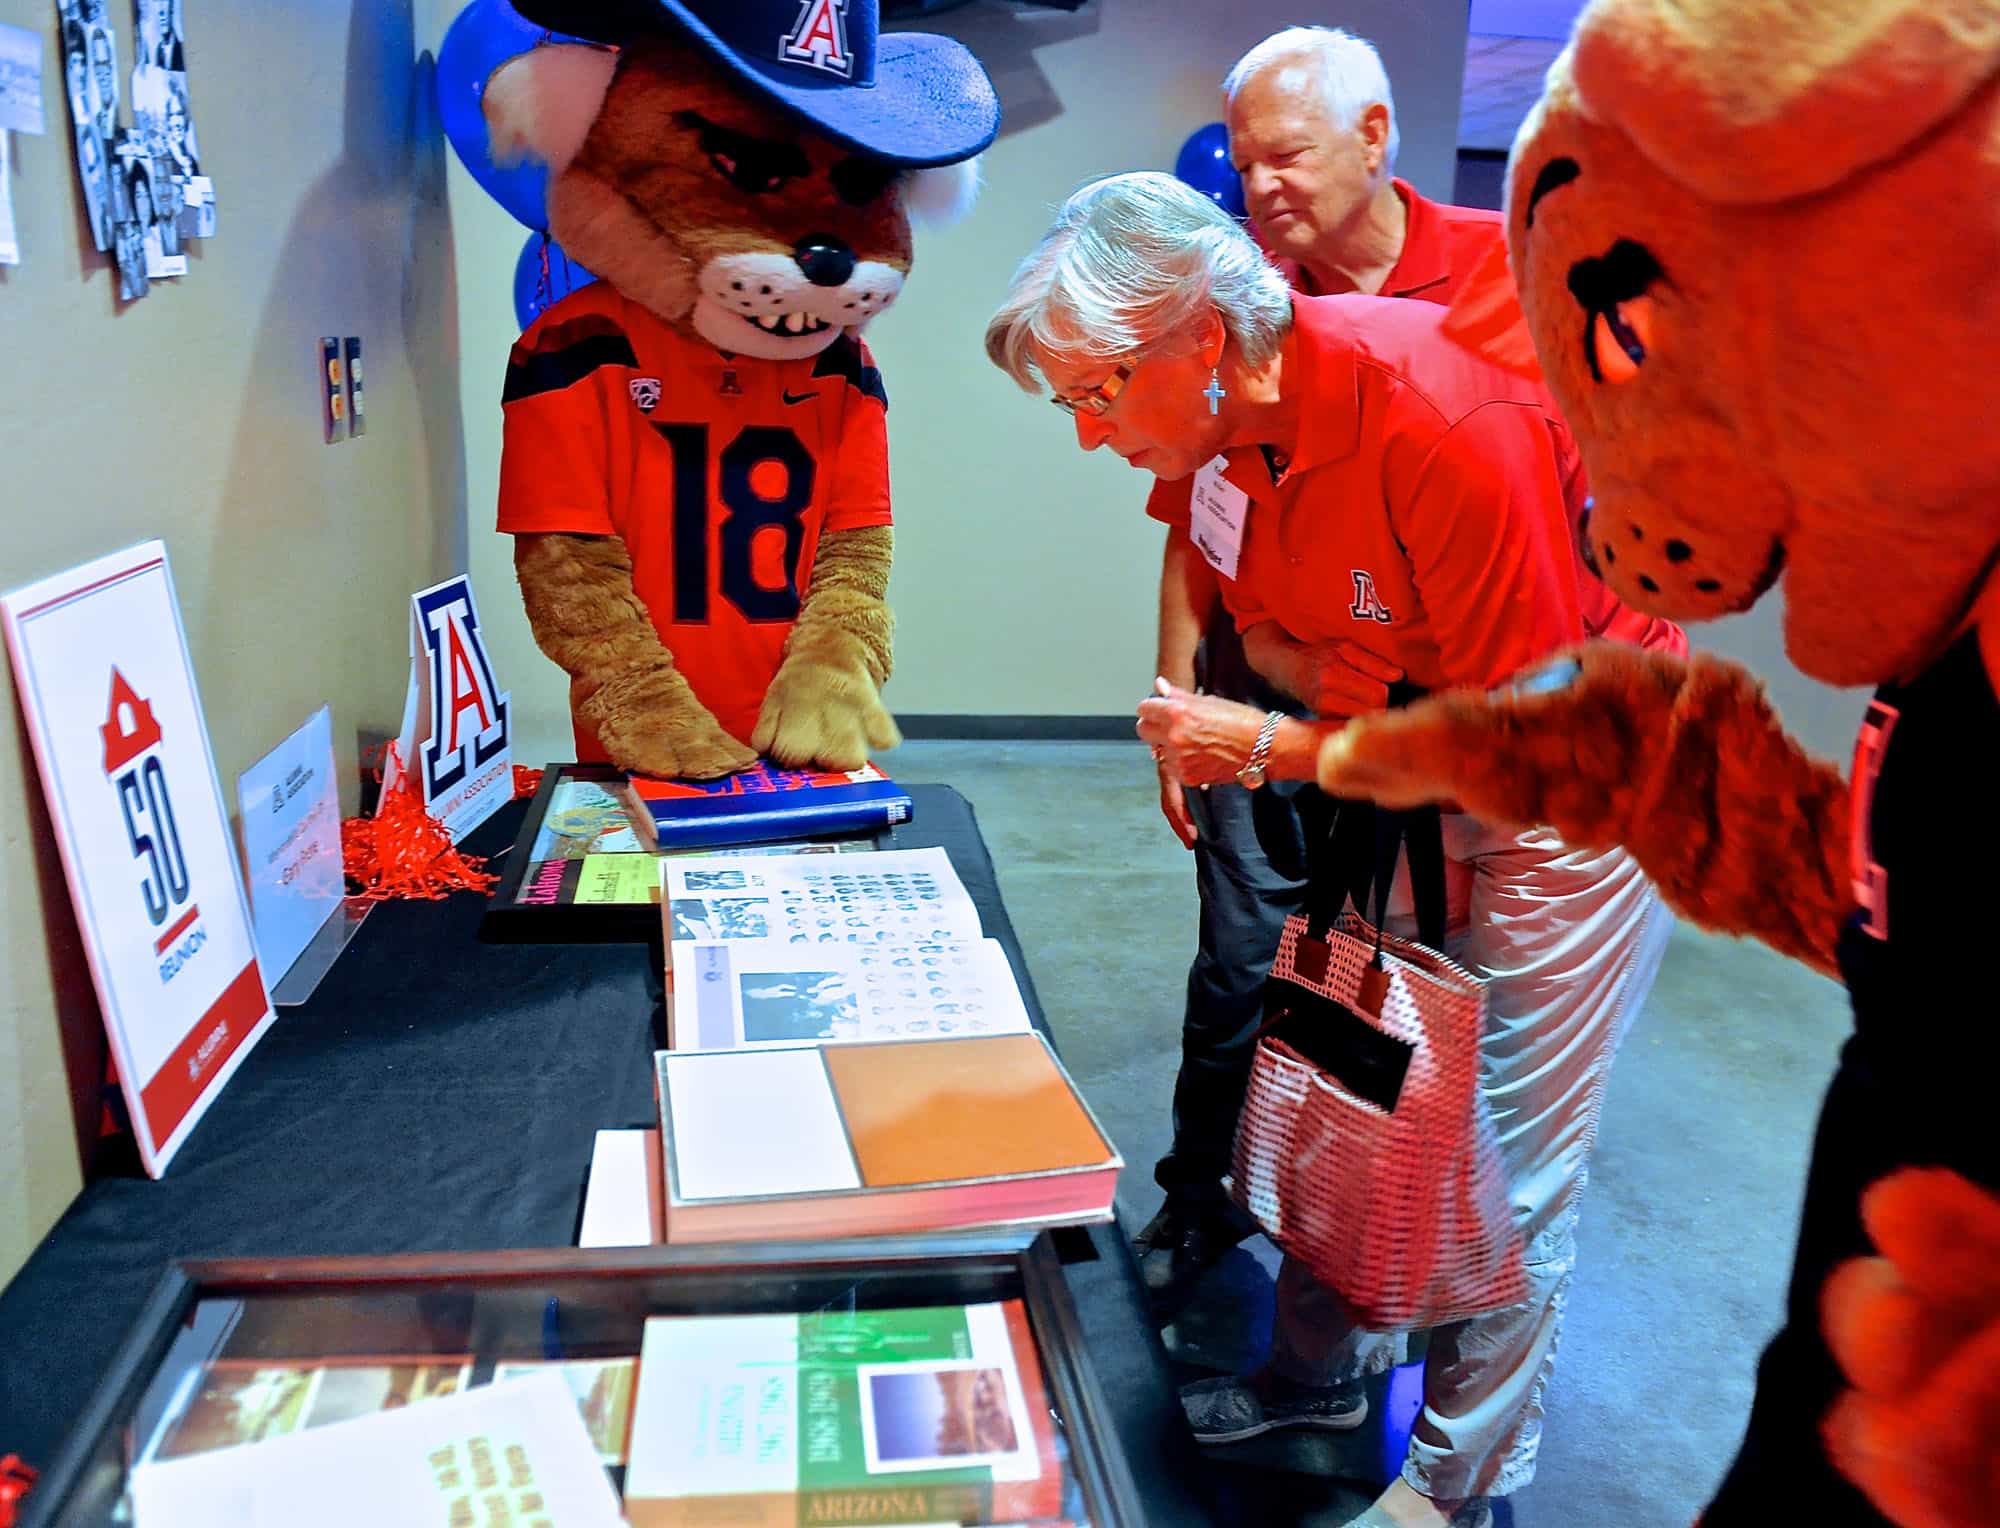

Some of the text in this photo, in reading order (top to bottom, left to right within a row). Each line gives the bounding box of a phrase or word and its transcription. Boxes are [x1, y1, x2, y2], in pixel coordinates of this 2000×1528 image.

[778, 0, 854, 78] A
[651, 422, 816, 624] 18
[1350, 570, 1392, 624] A
[418, 577, 508, 800] A
[117, 756, 190, 926] 50
[159, 928, 207, 984] REUNION
[808, 1493, 927, 1521] ARIZONA
